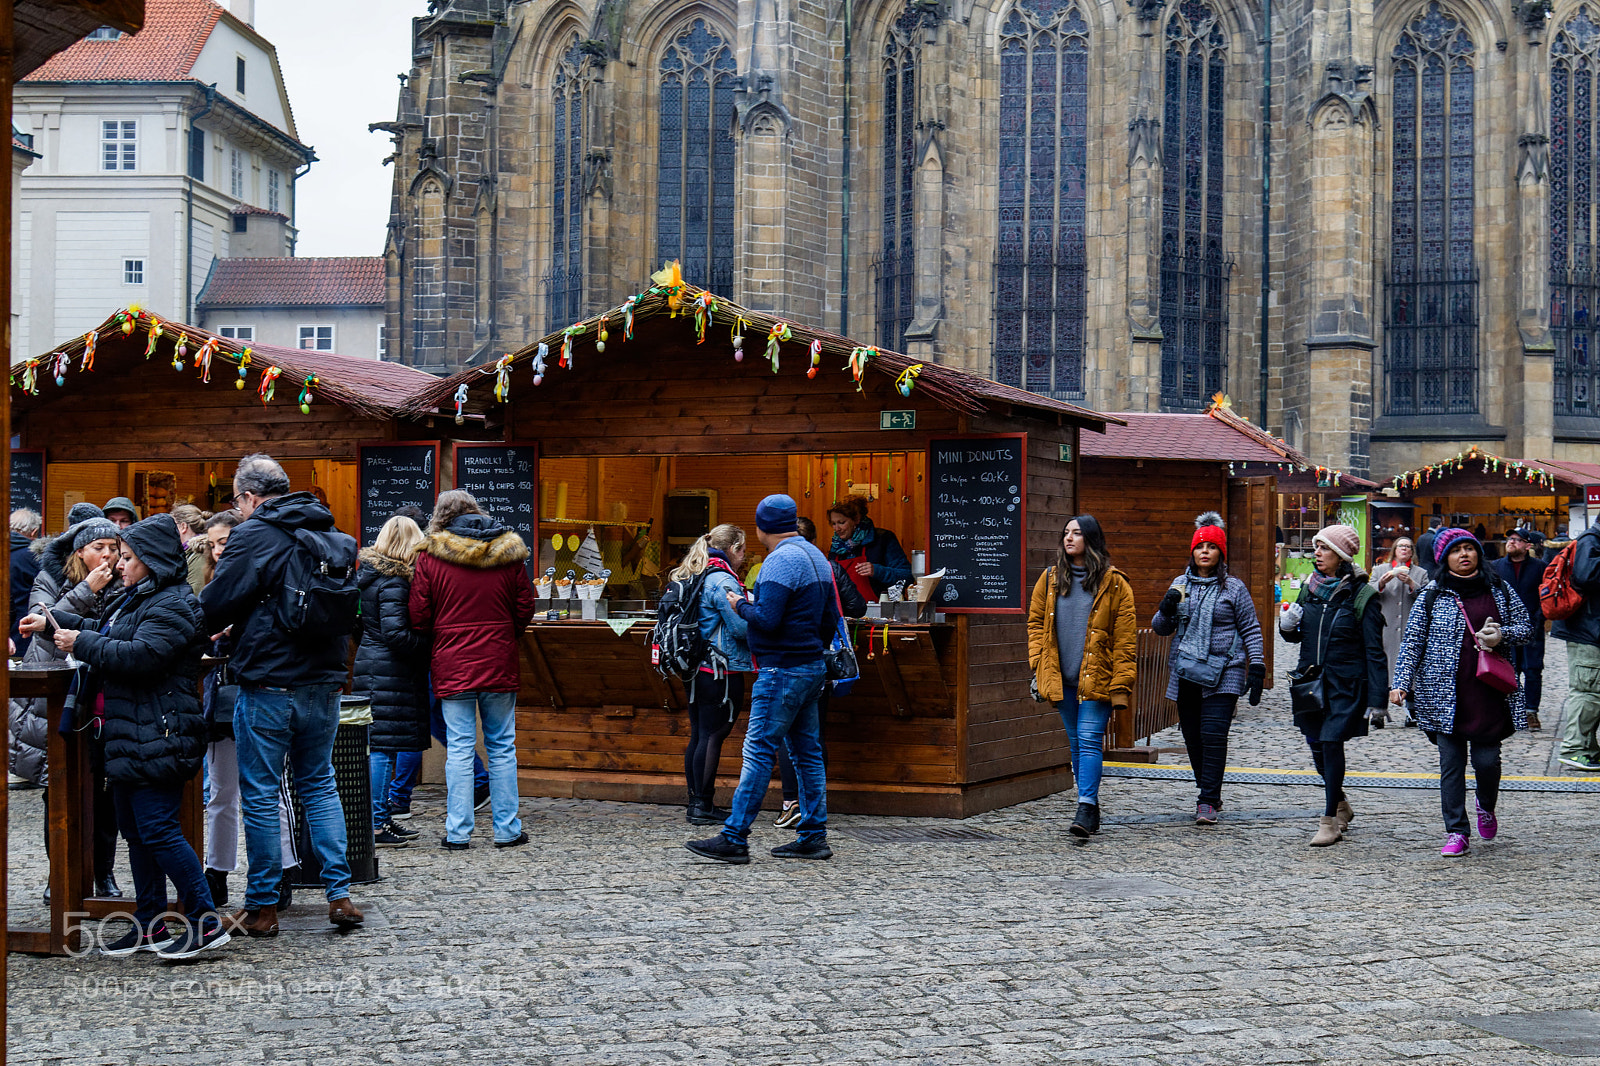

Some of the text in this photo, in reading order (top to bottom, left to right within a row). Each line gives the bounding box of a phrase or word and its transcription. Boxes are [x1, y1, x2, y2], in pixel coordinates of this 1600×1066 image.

[938, 449, 1014, 465] MINI DONUTS
[390, 478, 410, 486] DOG
[940, 473, 948, 483] 6
[488, 481, 495, 491] &
[938, 493, 950, 504] 12
[371, 510, 388, 518] FISH
[496, 505, 515, 513] CHIPS
